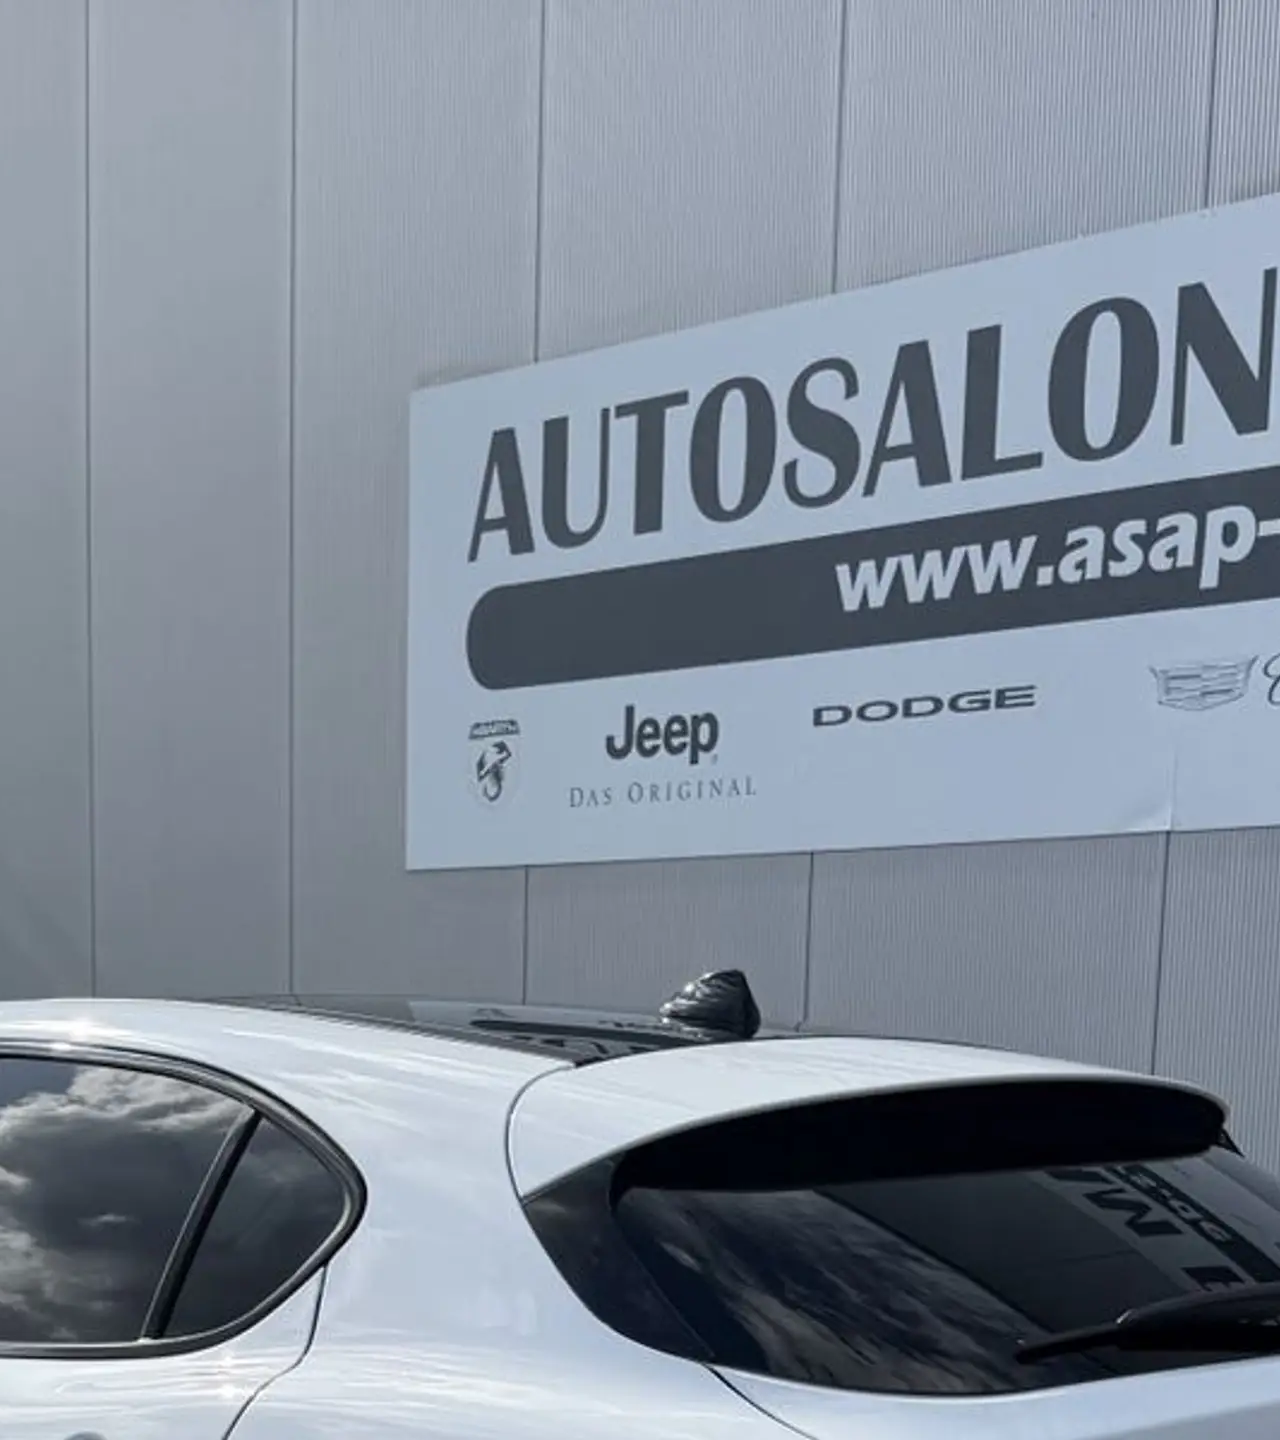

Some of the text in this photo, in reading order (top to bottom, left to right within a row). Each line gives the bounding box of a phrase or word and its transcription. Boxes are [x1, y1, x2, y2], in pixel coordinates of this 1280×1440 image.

[467, 267, 1277, 562] AUTOSALON
[606, 704, 720, 765] Jeep
[811, 685, 1037, 727] DODGE
